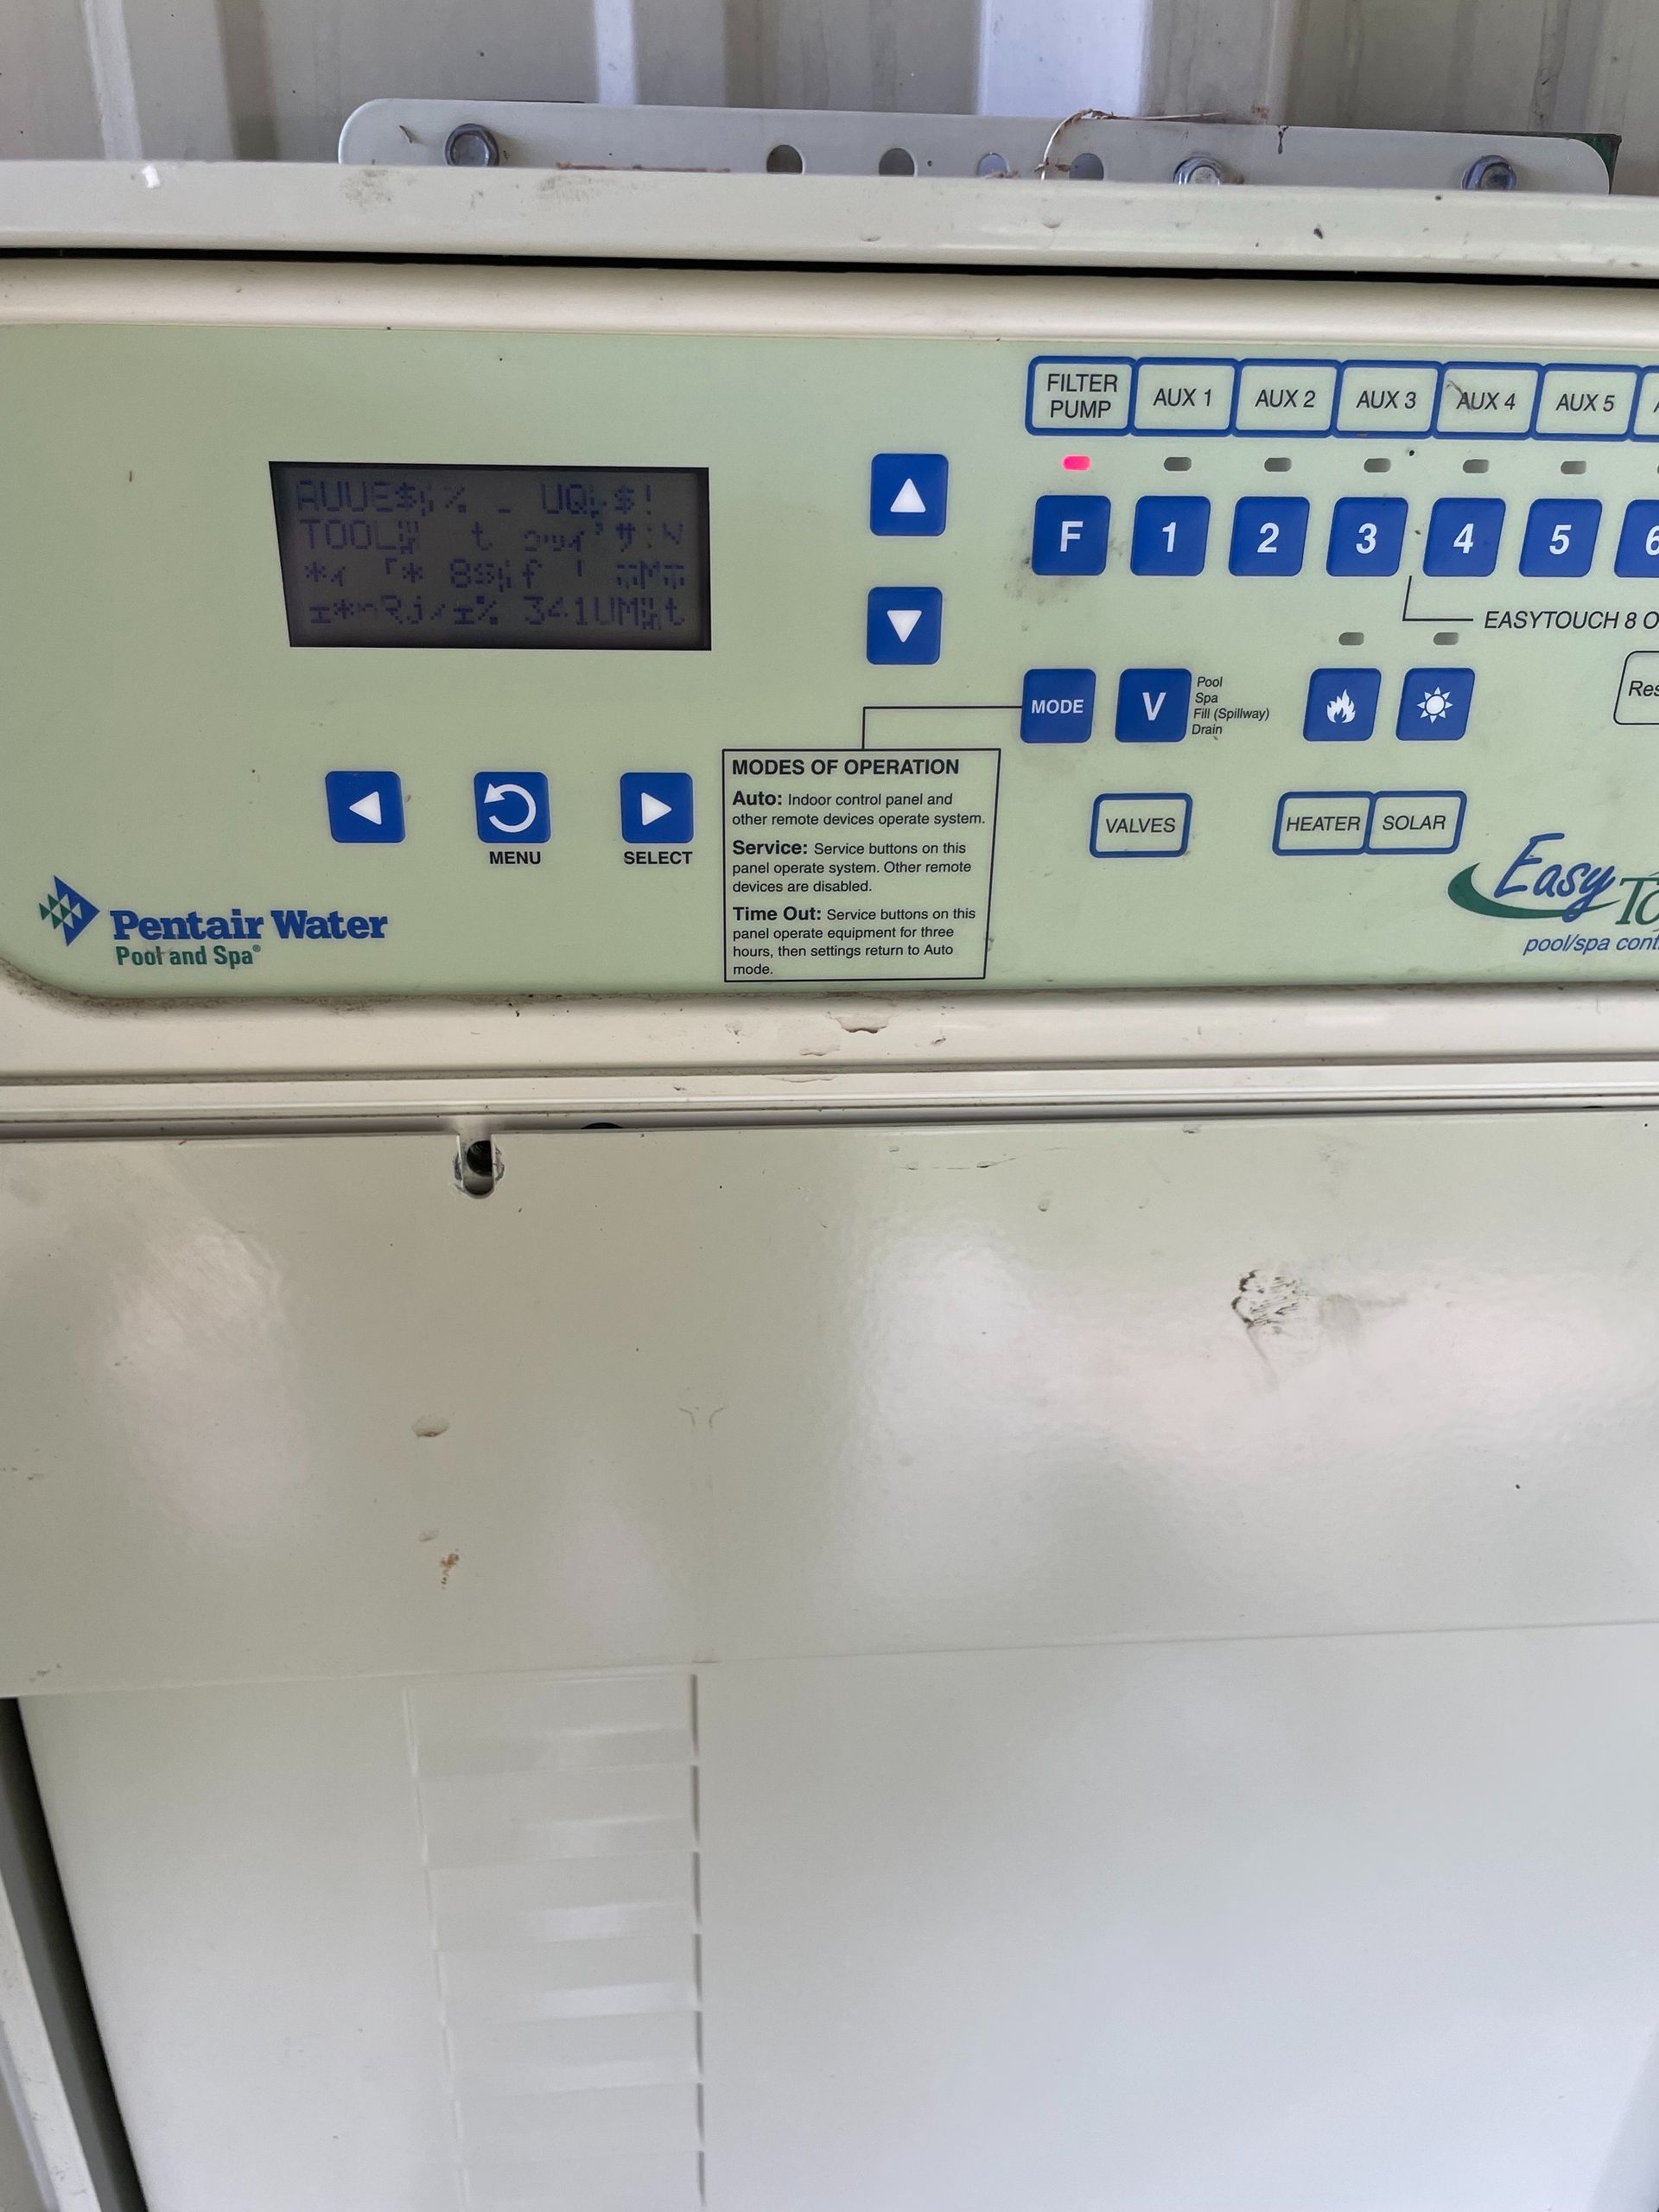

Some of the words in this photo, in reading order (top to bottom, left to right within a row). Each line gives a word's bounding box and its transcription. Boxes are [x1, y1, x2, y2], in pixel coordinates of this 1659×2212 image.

[1047, 372, 1118, 393] FILTER
[1153, 387, 1197, 407] AUX
[1204, 388, 1211, 407] 1
[1255, 389, 1299, 408] AUX
[1303, 390, 1316, 408] 2
[1356, 390, 1400, 410] AUX
[1404, 391, 1416, 410] 3
[1455, 389, 1500, 410] AUX
[1503, 392, 1516, 410] 4
[1554, 393, 1599, 412] AUX
[1602, 394, 1616, 412] 5
[1050, 399, 1111, 419] PUMP
[1059, 520, 1084, 552] F
[1162, 521, 1177, 553] 1
[1256, 522, 1280, 553] 2
[1356, 523, 1377, 555] 3
[1452, 523, 1474, 554] 4
[1549, 524, 1572, 555] 5
[1484, 610, 1620, 630] EASYTOUCH
[1624, 612, 1637, 630] 8
[1197, 676, 1224, 688] Pool
[1031, 699, 1084, 715] MODE
[1142, 691, 1166, 721] V
[1194, 691, 1218, 706] Spa
[1193, 708, 1211, 720] Fill
[1213, 707, 1270, 722] (Spillway)
[1192, 723, 1223, 735] Drain
[732, 759, 805, 776] MODES
[810, 759, 839, 776] OF
[843, 759, 959, 775] OPERATION
[732, 790, 782, 806] Auto:
[788, 793, 832, 806] Indoor
[835, 793, 881, 806] control
[886, 792, 923, 809] panel
[926, 792, 953, 805] and
[732, 812, 768, 825] other
[772, 813, 819, 826] remote
[823, 812, 874, 825] devices
[878, 813, 930, 828] operate
[933, 812, 985, 828] system.
[1105, 817, 1176, 834] VALVES
[1286, 816, 1361, 832] HEATER
[1382, 815, 1446, 831] SOLAR
[732, 839, 808, 855] Service:
[814, 842, 865, 855] Service
[868, 842, 918, 855] buttons
[922, 844, 938, 855] on
[943, 842, 966, 855] this
[489, 850, 541, 865] MENU
[623, 850, 693, 865] SELECT
[732, 861, 770, 877] panel
[773, 862, 825, 877] operate
[829, 861, 880, 877] system.
[883, 861, 922, 874] Other
[925, 861, 972, 873] remote
[732, 880, 784, 893] devices
[787, 882, 810, 893] are
[812, 880, 872, 893] disabled.
[732, 906, 778, 921] Time
[783, 906, 822, 921] Out:
[826, 908, 876, 921] Service
[880, 908, 929, 920] buttons
[932, 910, 949, 919] on
[952, 907, 976, 919] this
[109, 908, 264, 941] Pentair
[270, 910, 388, 940] Water
[733, 927, 769, 942] panel
[772, 927, 823, 942] operate
[827, 926, 897, 941] equipment
[899, 925, 918, 938] for
[920, 925, 955, 938] three
[733, 945, 773, 959] hours,
[778, 945, 806, 957] then
[810, 944, 861, 959] settings
[865, 944, 904, 957] return
[907, 944, 920, 956] to
[923, 944, 954, 956] Auto
[1522, 934, 1611, 956] pool/spa
[116, 945, 163, 965] Pool
[170, 945, 207, 965] and
[733, 963, 773, 976] mode.
